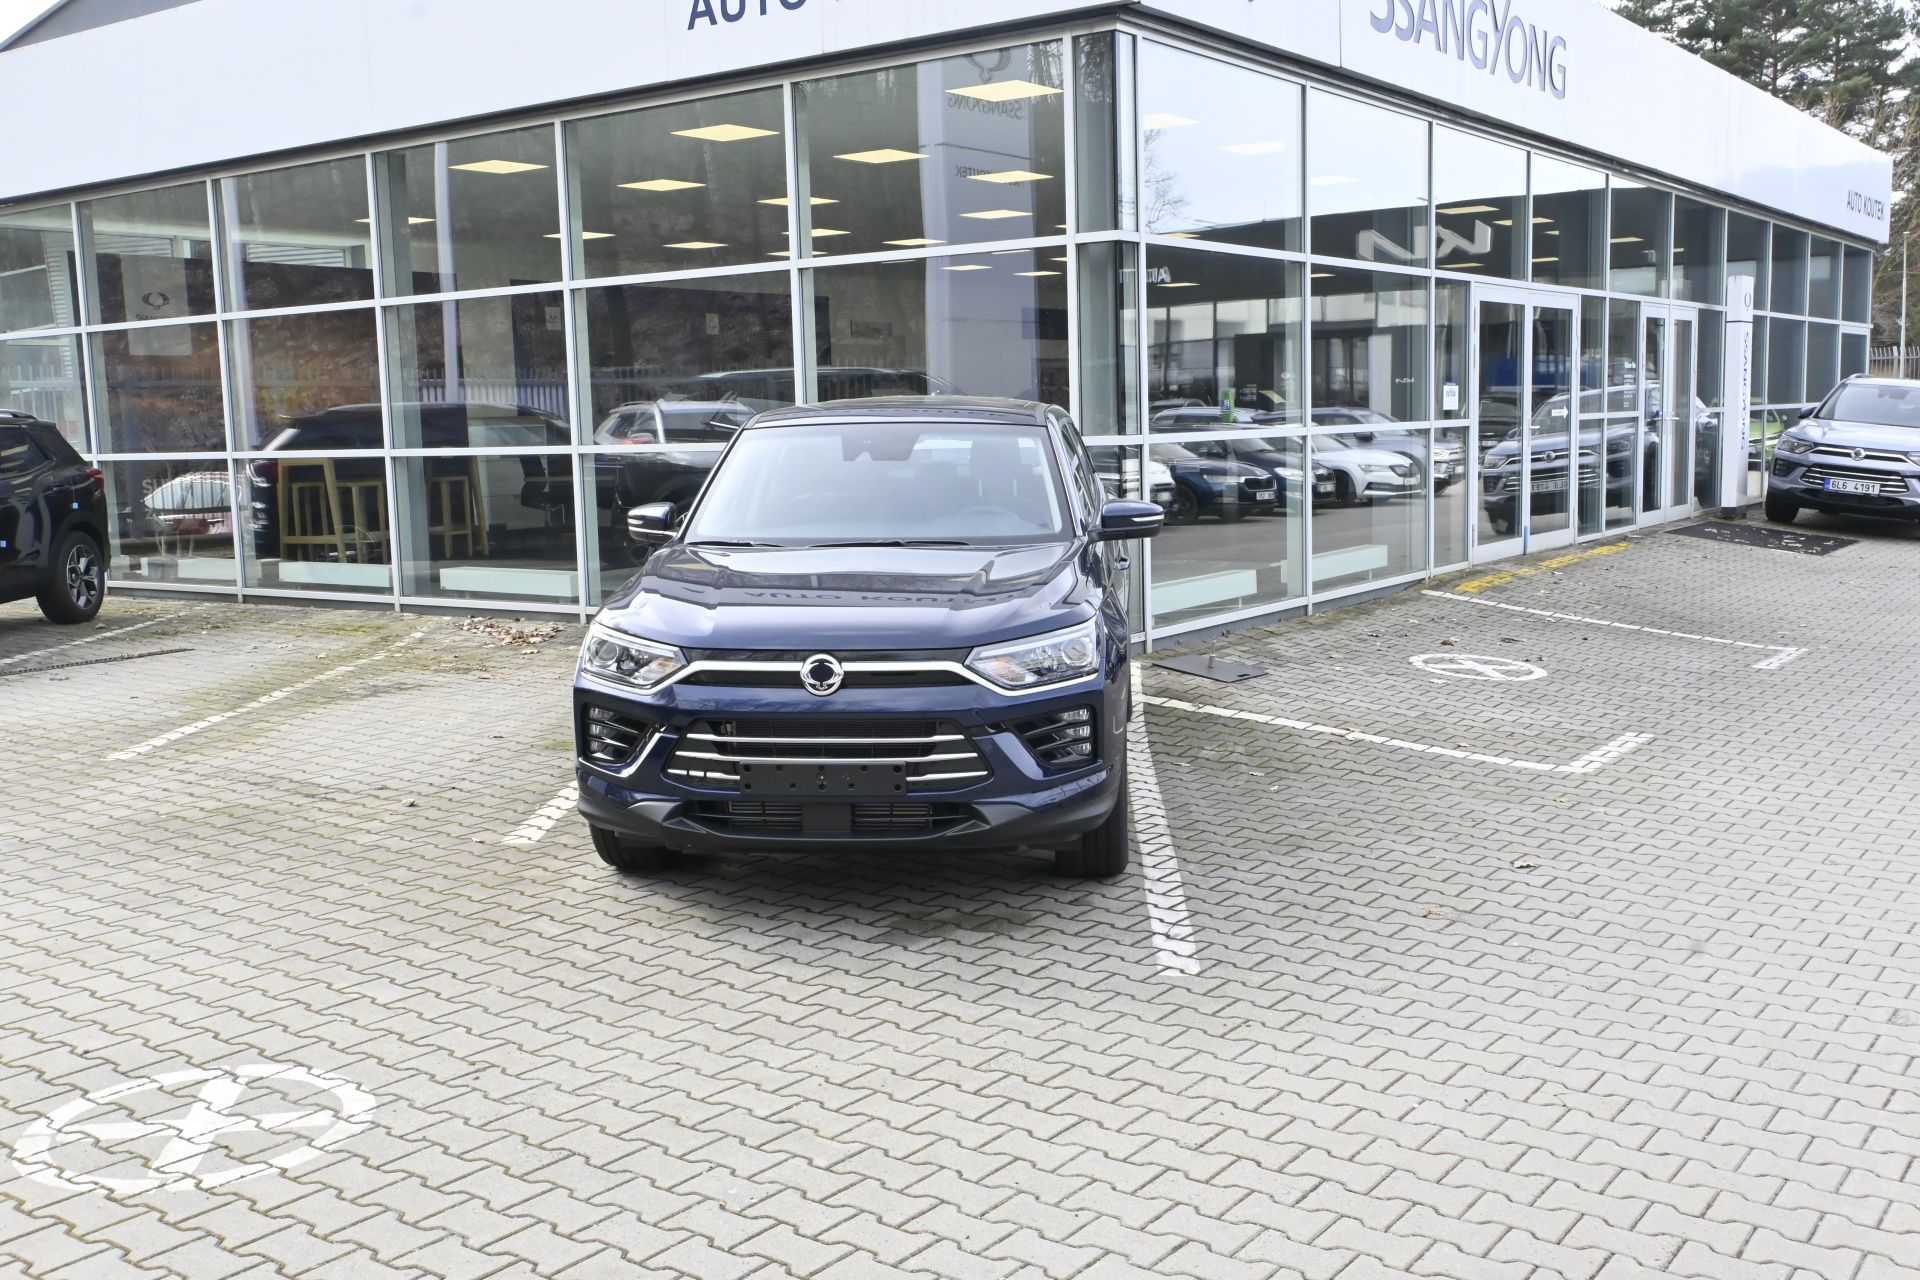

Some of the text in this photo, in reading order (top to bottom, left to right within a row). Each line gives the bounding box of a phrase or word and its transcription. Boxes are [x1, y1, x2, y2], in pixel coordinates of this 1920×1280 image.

[687, 0, 807, 30] AU
[1847, 189, 1885, 221] AUTO KOUTEK
[1831, 480, 1876, 493] 6L6 4191
